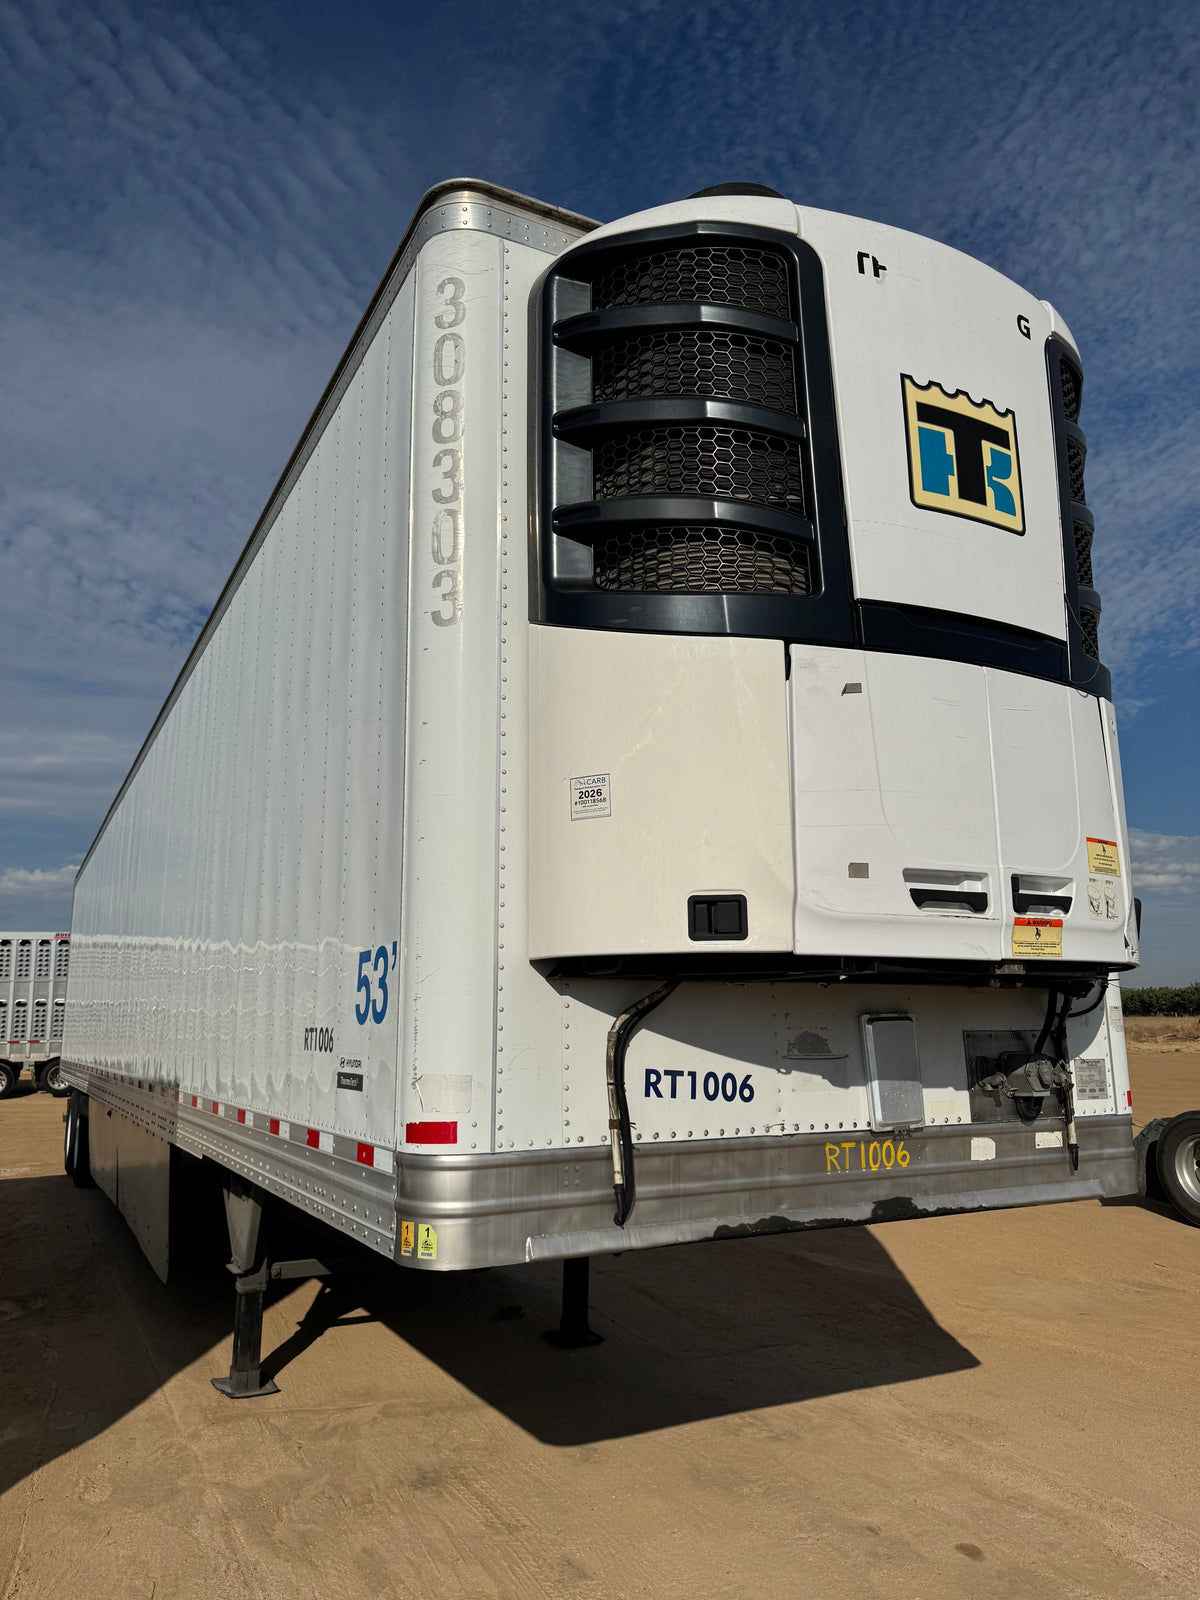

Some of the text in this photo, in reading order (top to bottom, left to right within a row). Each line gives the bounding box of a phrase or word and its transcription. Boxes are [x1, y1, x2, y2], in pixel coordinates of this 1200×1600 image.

[430, 276, 467, 628] 308303
[578, 789, 602, 799] 2026
[586, 777, 606, 785] CARB
[303, 1027, 334, 1053] RT1006
[644, 1068, 755, 1102] RT1006
[825, 1139, 911, 1175] RT1006
